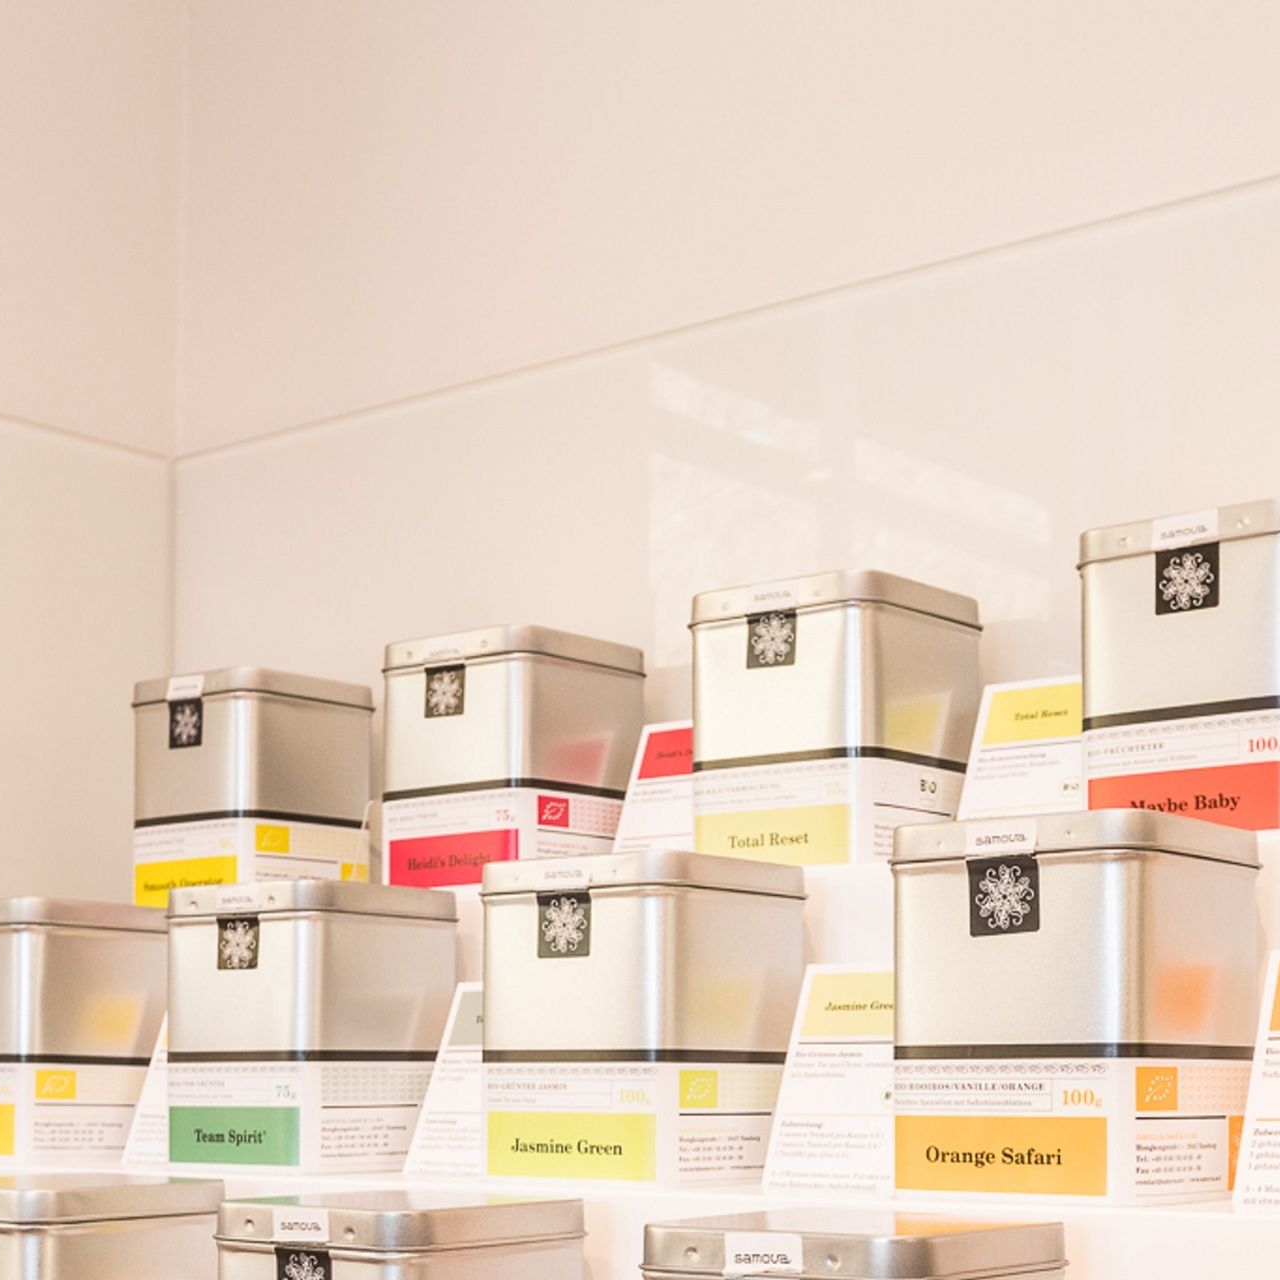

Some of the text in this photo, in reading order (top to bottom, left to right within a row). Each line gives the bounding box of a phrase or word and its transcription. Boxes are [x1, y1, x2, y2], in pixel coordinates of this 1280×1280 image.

[1014, 711, 1039, 721] Total
[1194, 792, 1241, 812] Baby
[728, 831, 809, 849] Total Reset
[975, 833, 1028, 847] samova
[407, 856, 446, 871] Heidi's
[870, 1000, 894, 1011] Gree
[1061, 1088, 1103, 1108] 100g
[193, 1127, 225, 1143] Team
[510, 1137, 623, 1156] Jasmine Green
[925, 1144, 1063, 1168] Orange Safari
[734, 1252, 792, 1265] samova
